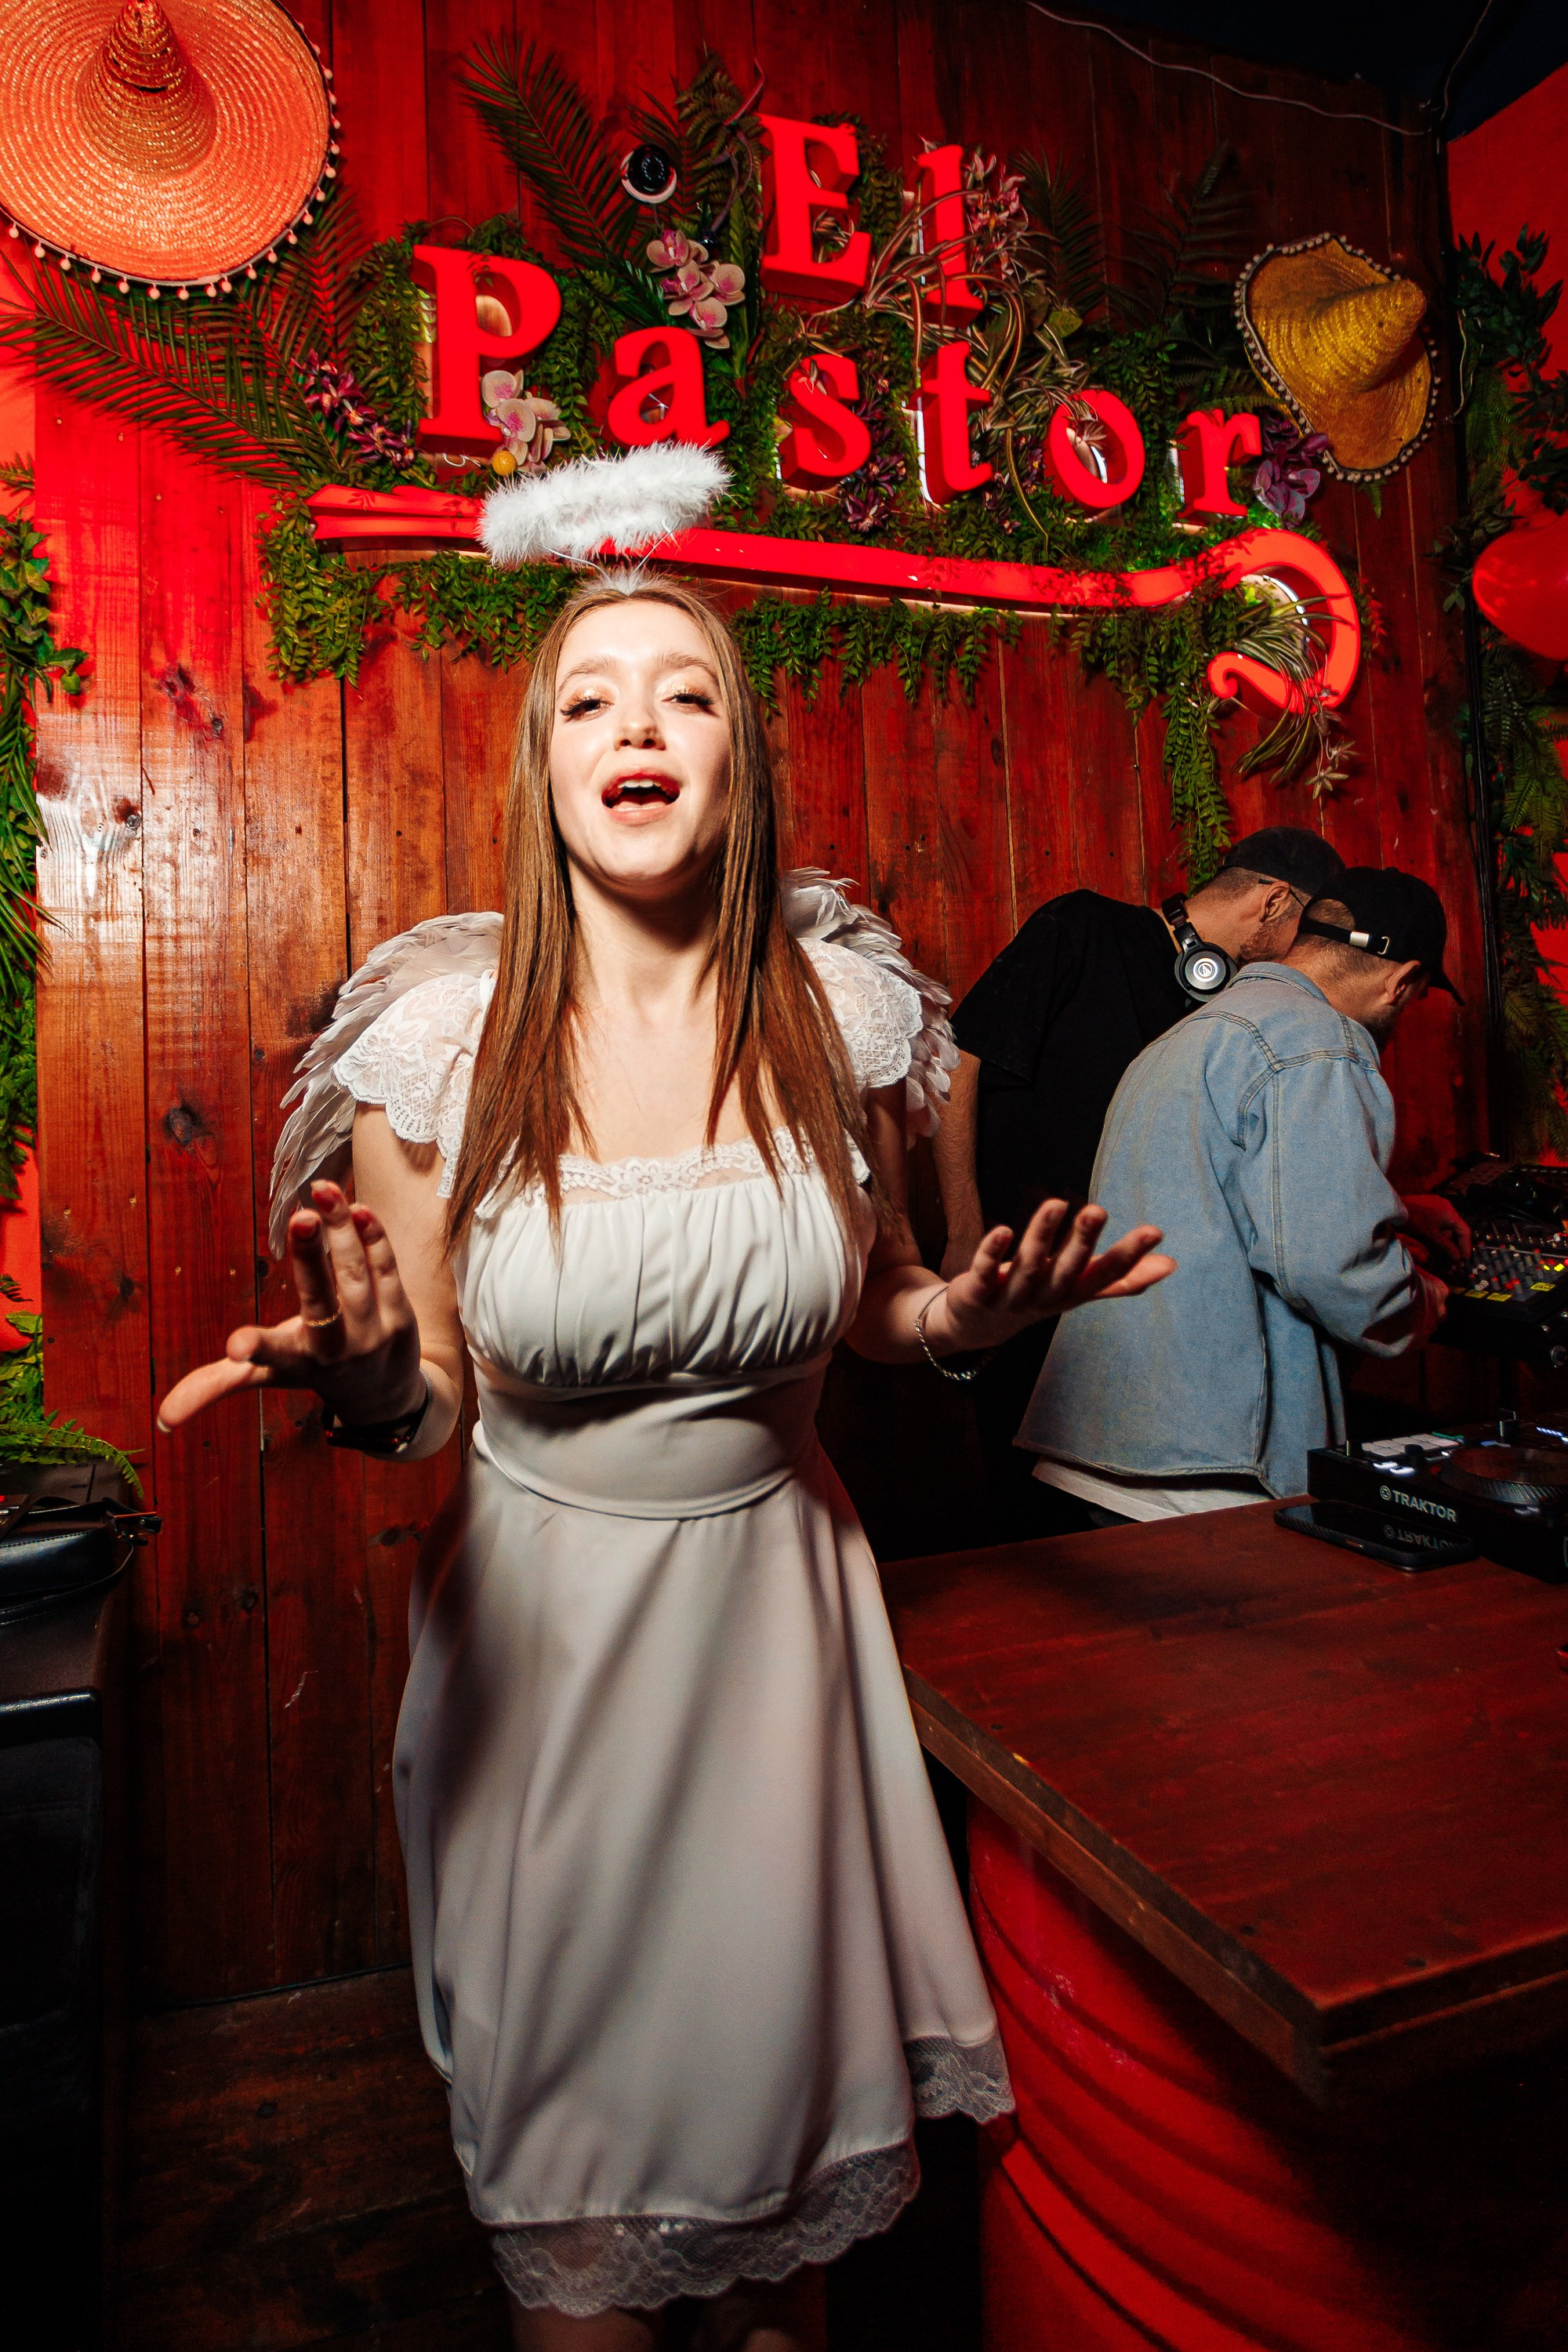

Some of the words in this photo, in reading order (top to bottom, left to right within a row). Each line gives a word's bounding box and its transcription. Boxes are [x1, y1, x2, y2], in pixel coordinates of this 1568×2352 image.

[757, 113, 984, 314] El
[412, 244, 1262, 517] Pastor
[1392, 1490, 1457, 1523] TRAKTOR
